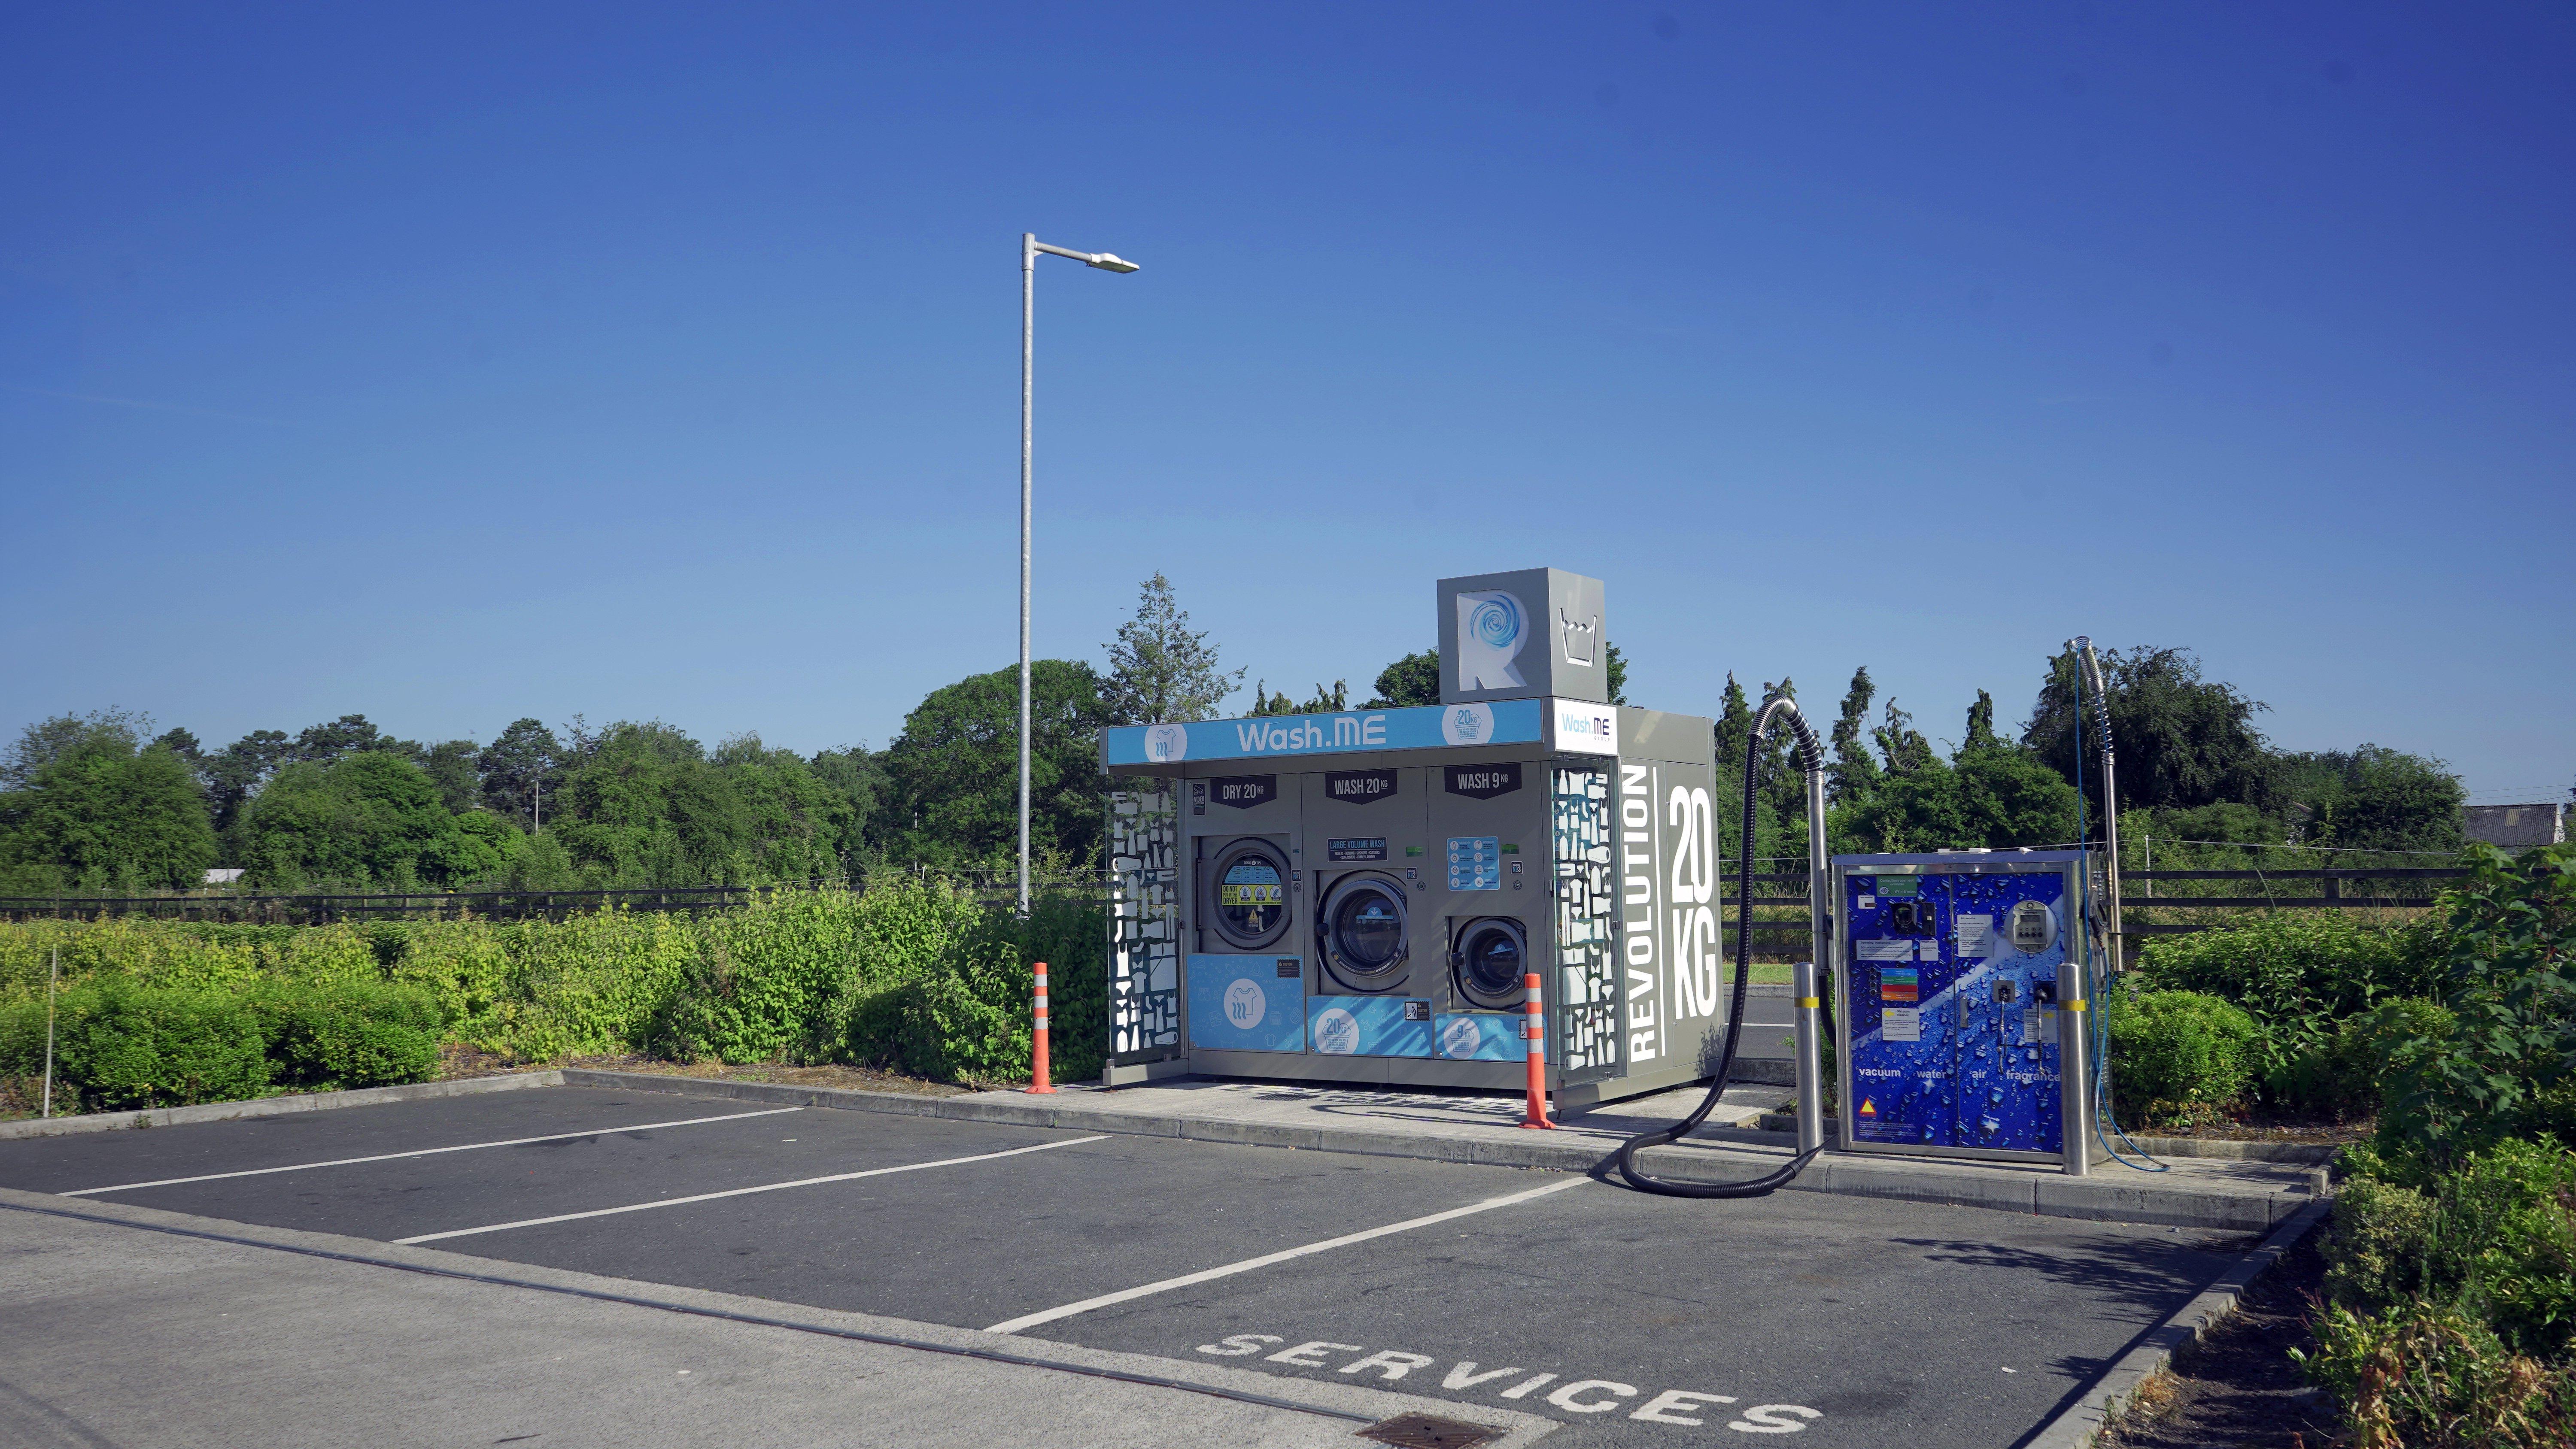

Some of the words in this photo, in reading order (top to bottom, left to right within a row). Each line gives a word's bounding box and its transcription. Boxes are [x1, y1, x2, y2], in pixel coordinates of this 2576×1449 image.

[1457, 589, 1529, 692] R
[1562, 713, 1609, 735] Wash.ME
[1236, 715, 1386, 752] Wash.ME
[1334, 779, 1364, 794] WASH
[1458, 773, 1489, 789] WASH
[1492, 773, 1500, 788] 9
[1223, 784, 1242, 800] DRY
[1330, 841, 1346, 849] LARGE
[1348, 840, 1368, 849] VOLUME
[1370, 840, 1385, 848] WASH
[1669, 785, 1713, 904] 20
[1622, 764, 1656, 1063] REVOLUTION
[1672, 906, 1717, 1020] KG
[1327, 1018, 1340, 1034] 20
[1457, 1025, 1463, 1038] 9
[1465, 1030, 1471, 1038] KG
[1859, 1068, 1901, 1077] vacuum
[1916, 1069, 1947, 1079] water
[1971, 1069, 1987, 1079] air
[2005, 1070, 2060, 1082] fragrance
[1195, 1334, 1824, 1434] SERVICES
